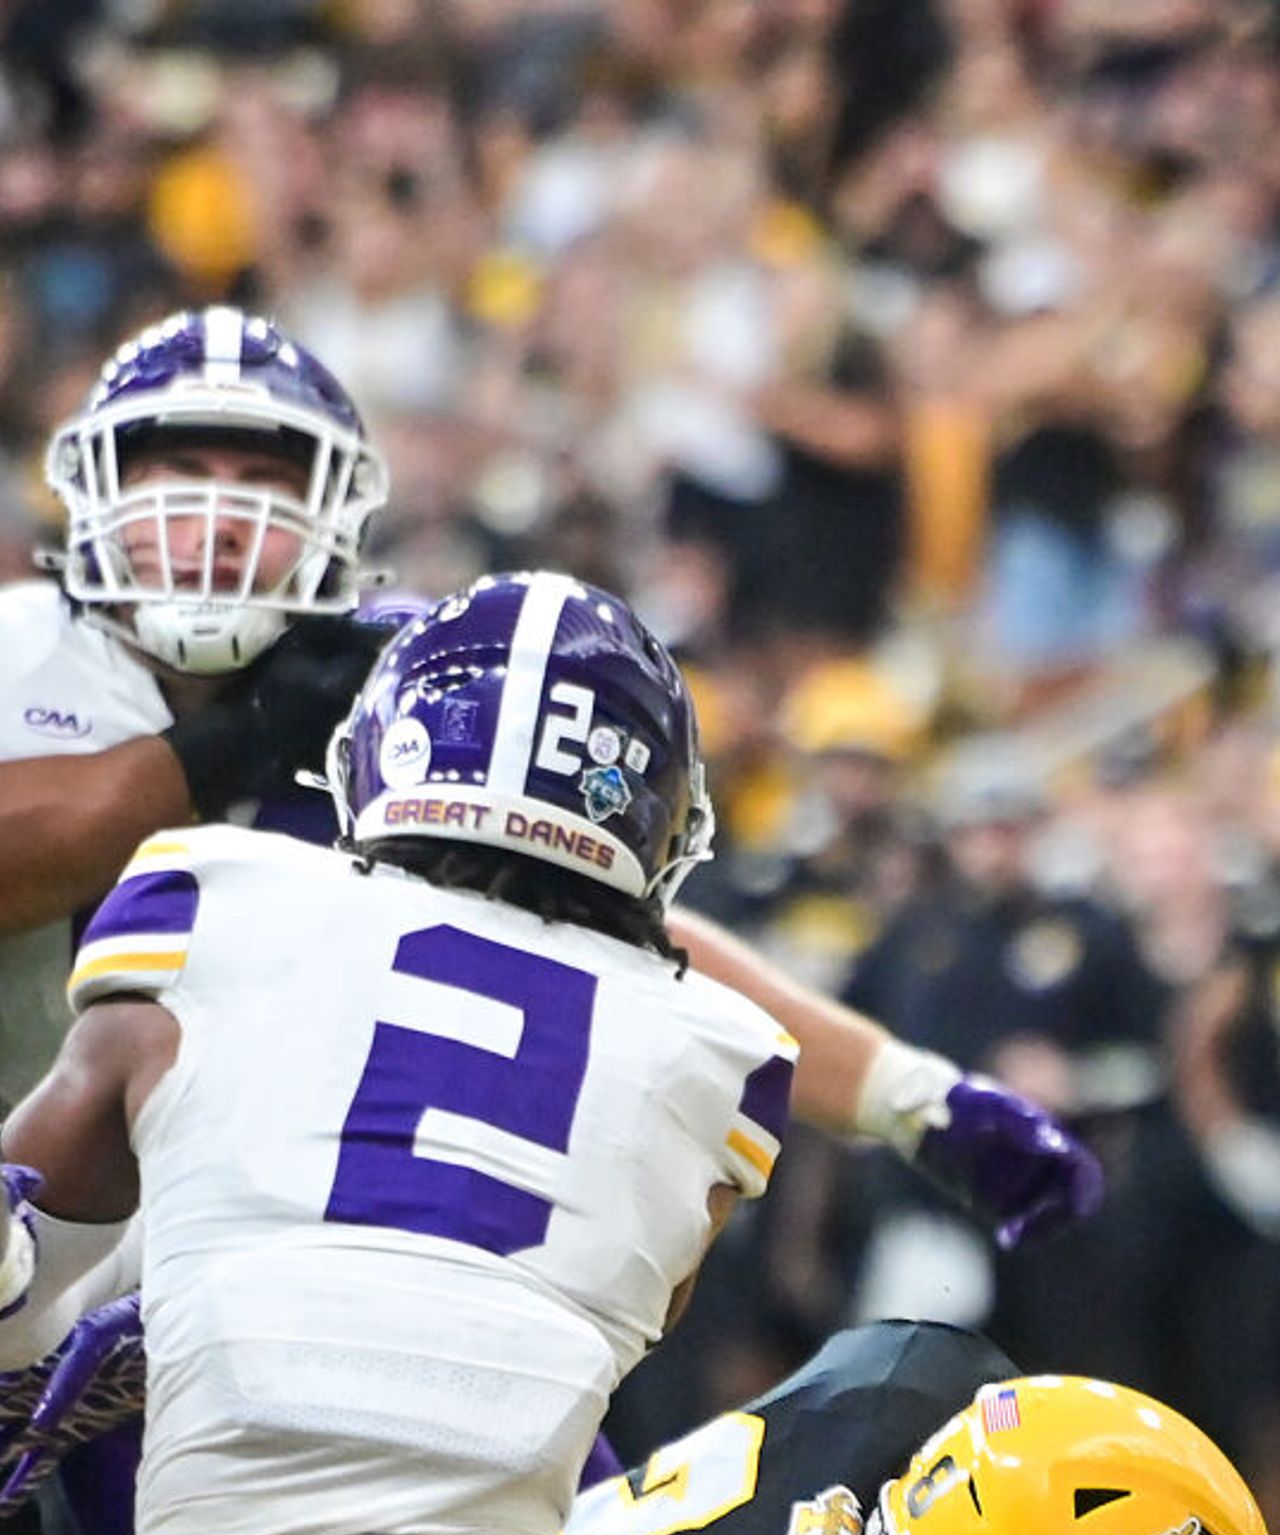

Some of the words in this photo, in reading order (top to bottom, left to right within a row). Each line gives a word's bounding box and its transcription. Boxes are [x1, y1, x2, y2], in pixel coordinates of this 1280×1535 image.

[535, 682, 595, 777] 2
[383, 799, 491, 831] GREAT
[504, 812, 616, 868] DANES
[323, 923, 599, 1257] 2
